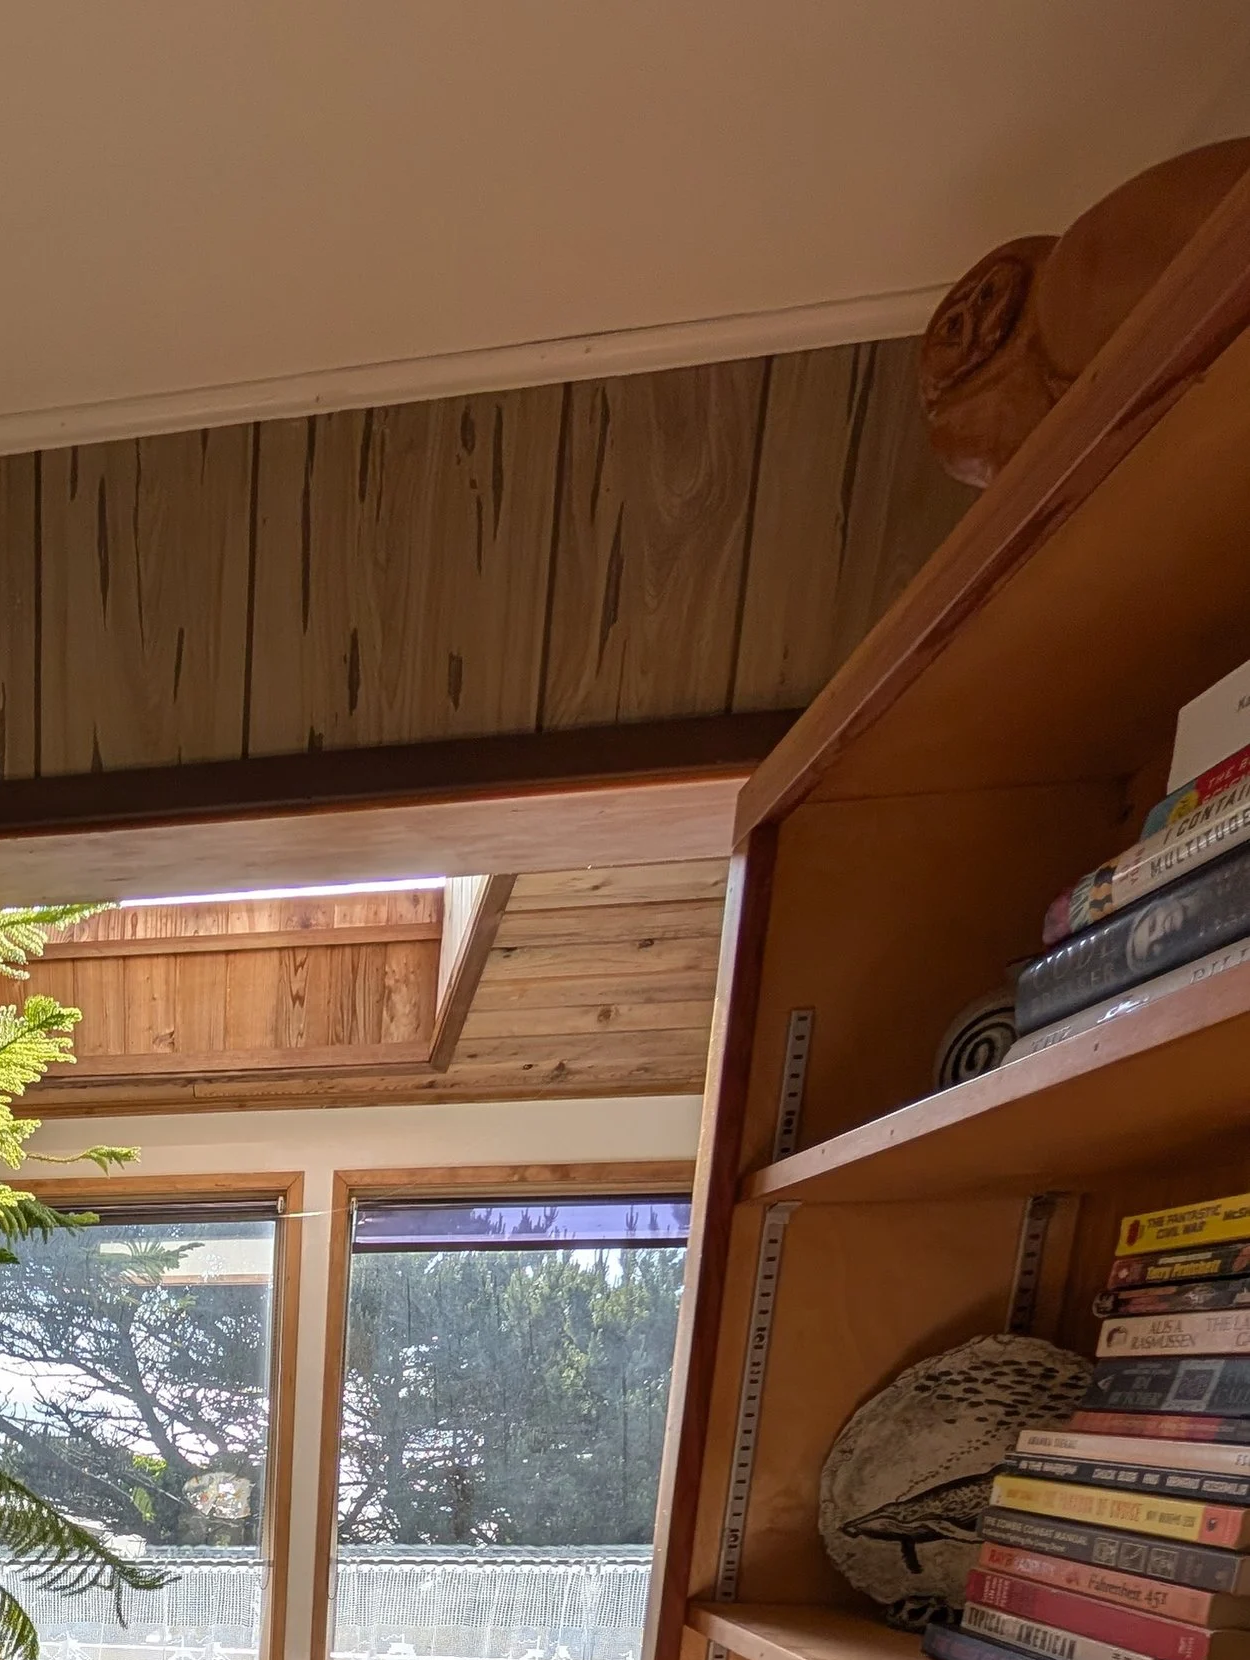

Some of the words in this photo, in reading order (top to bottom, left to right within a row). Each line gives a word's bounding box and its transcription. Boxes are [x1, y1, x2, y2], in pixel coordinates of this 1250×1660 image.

[1147, 1216, 1164, 1228] THE
[1166, 1204, 1222, 1222] FANTASTIC
[1156, 1226, 1179, 1239] CIVIL
[1182, 1221, 1206, 1233] WAR
[1206, 1316, 1232, 1331] THE
[1022, 1523, 1054, 1537] COMBAT
[1054, 1530, 1088, 1546] MANUAL
[1087, 1573, 1142, 1601] Fahrenheit
[1143, 1592, 1168, 1609] 451
[967, 1606, 1004, 1636] TYPICAL
[1016, 1623, 1077, 1660] AMERICAN
